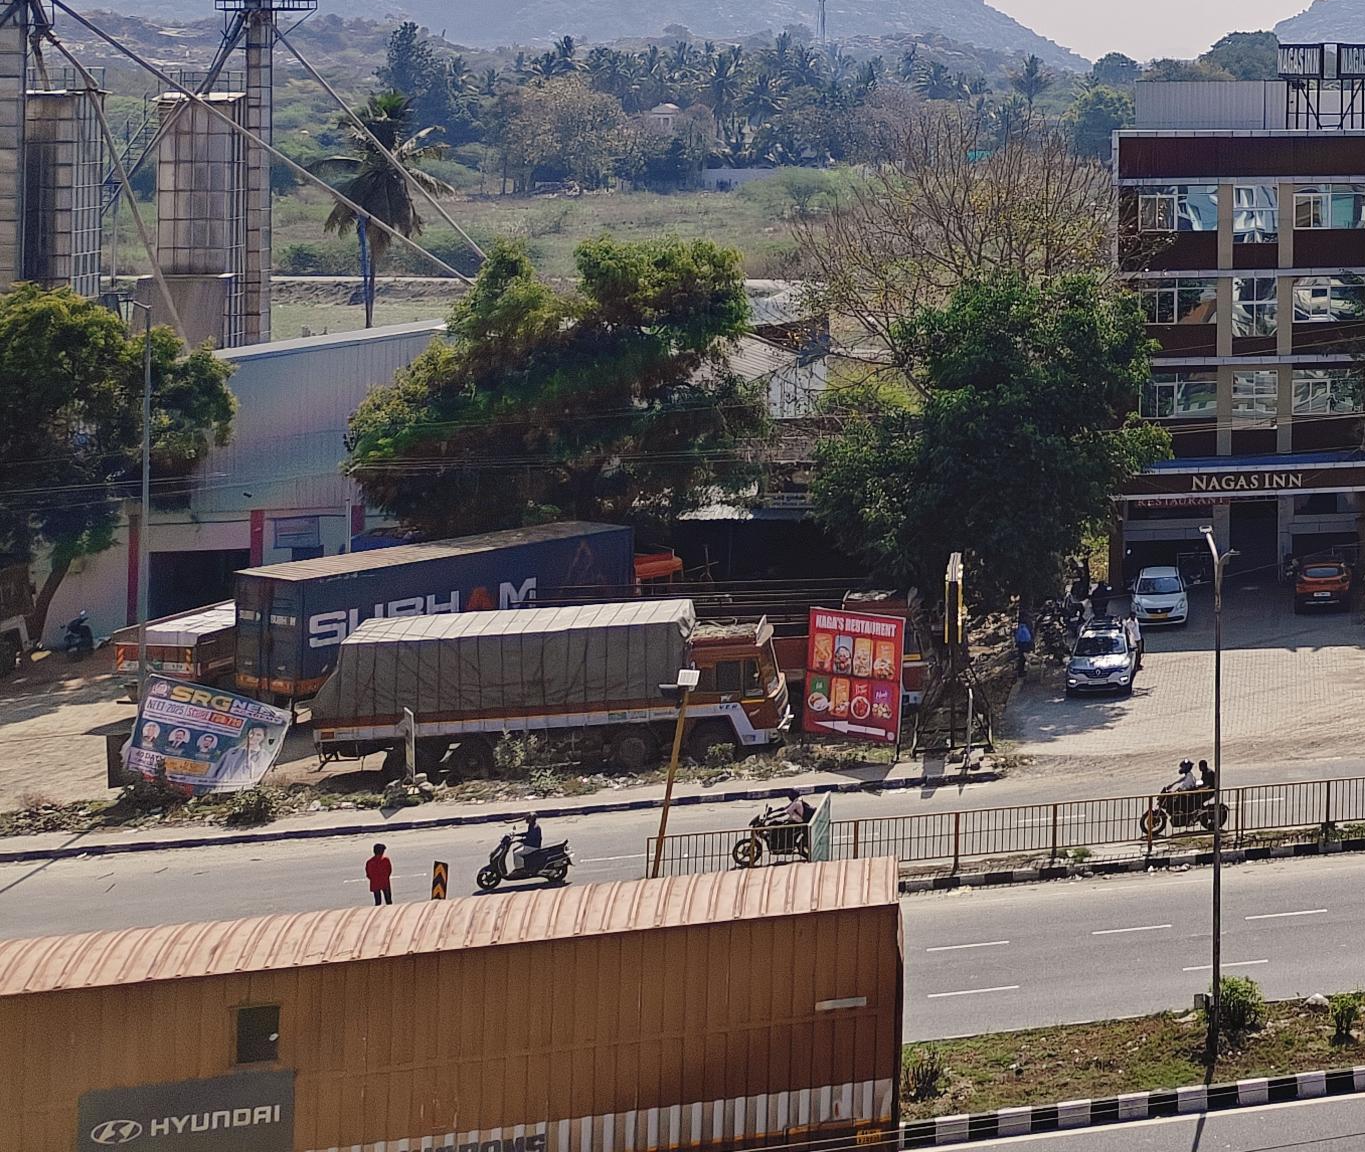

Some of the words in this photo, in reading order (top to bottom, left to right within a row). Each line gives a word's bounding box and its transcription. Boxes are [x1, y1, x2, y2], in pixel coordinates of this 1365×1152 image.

[1191, 474, 1259, 491] NAGAS
[1264, 473, 1302, 489] INN
[1137, 496, 1225, 508] RESTAURANT
[815, 614, 845, 630] NAGA'S
[170, 685, 234, 713] SRG
[150, 1104, 281, 1137] HYUNDAI
